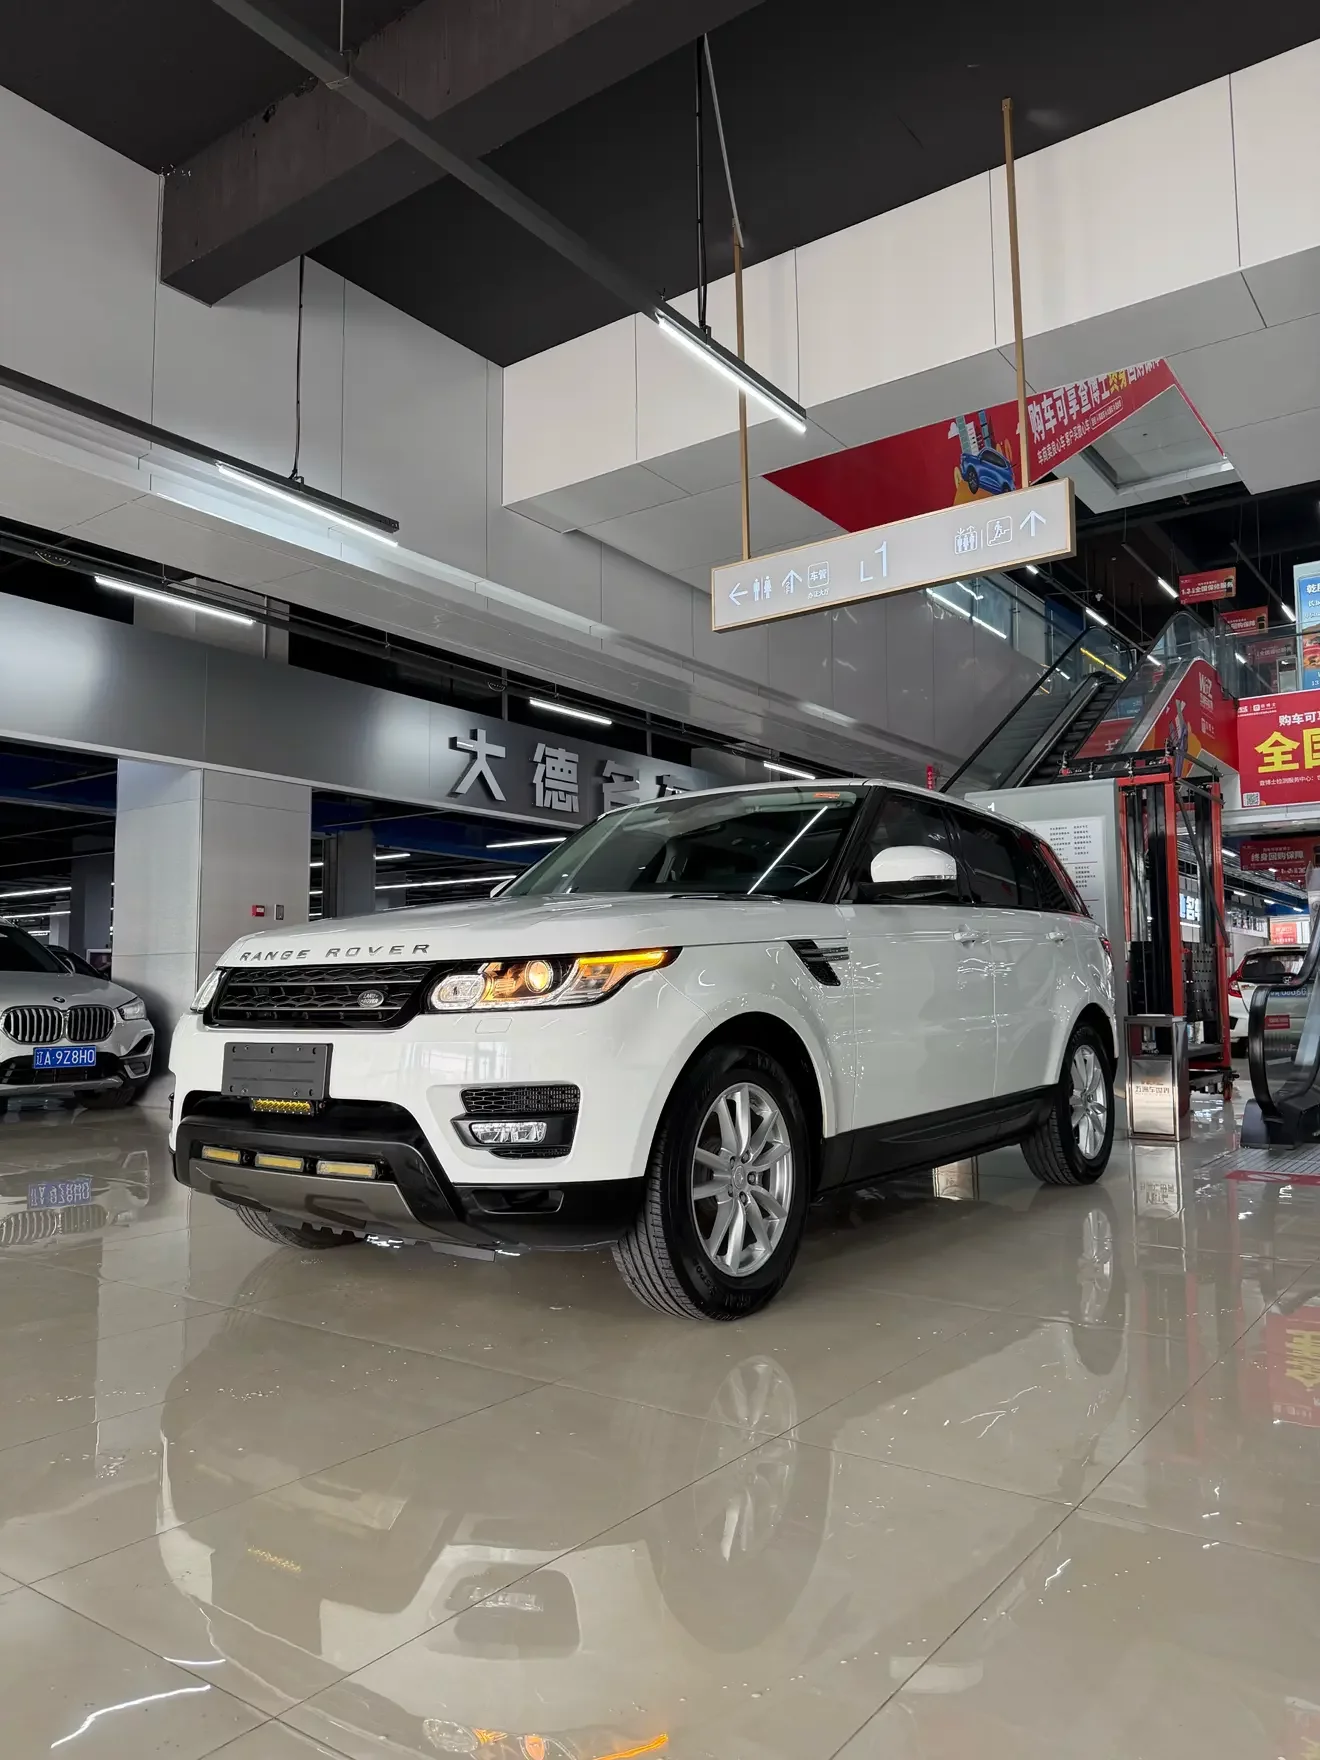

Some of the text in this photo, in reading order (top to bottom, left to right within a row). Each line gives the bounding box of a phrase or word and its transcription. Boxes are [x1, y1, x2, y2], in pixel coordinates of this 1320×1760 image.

[860, 540, 888, 582] L1
[810, 568, 827, 581] 车管
[239, 944, 430, 962] RANGE ROVER
